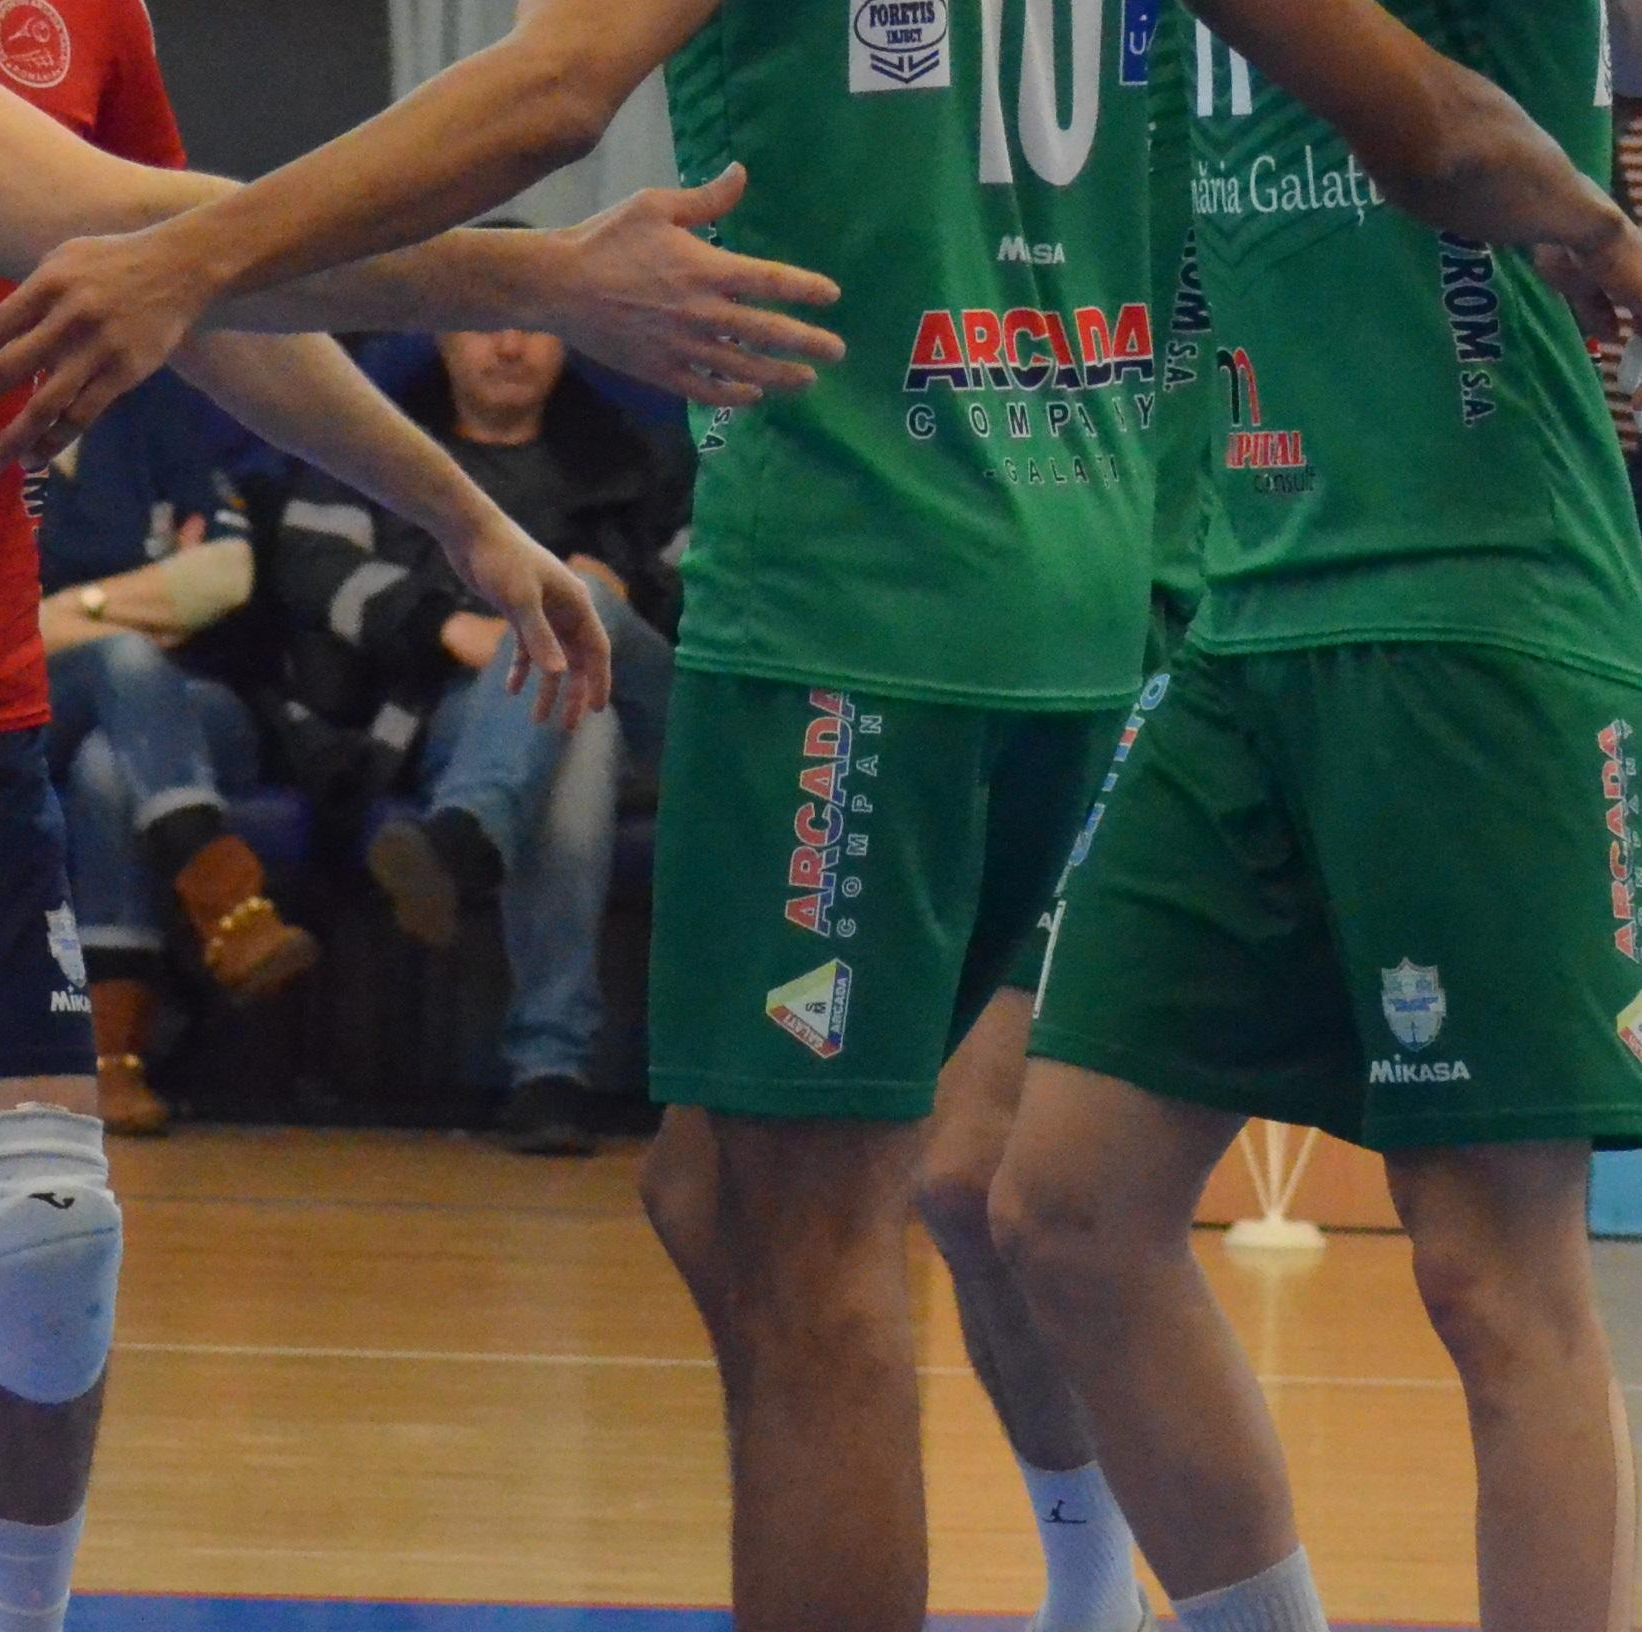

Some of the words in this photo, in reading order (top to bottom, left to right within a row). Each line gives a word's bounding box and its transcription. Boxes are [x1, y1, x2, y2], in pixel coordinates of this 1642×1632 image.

[903, 302, 1155, 391] ARCADA
[785, 688, 856, 937] ARCADA
[1597, 718, 1641, 965] ARCADA
[1369, 1053, 1471, 1084] MIKASA
